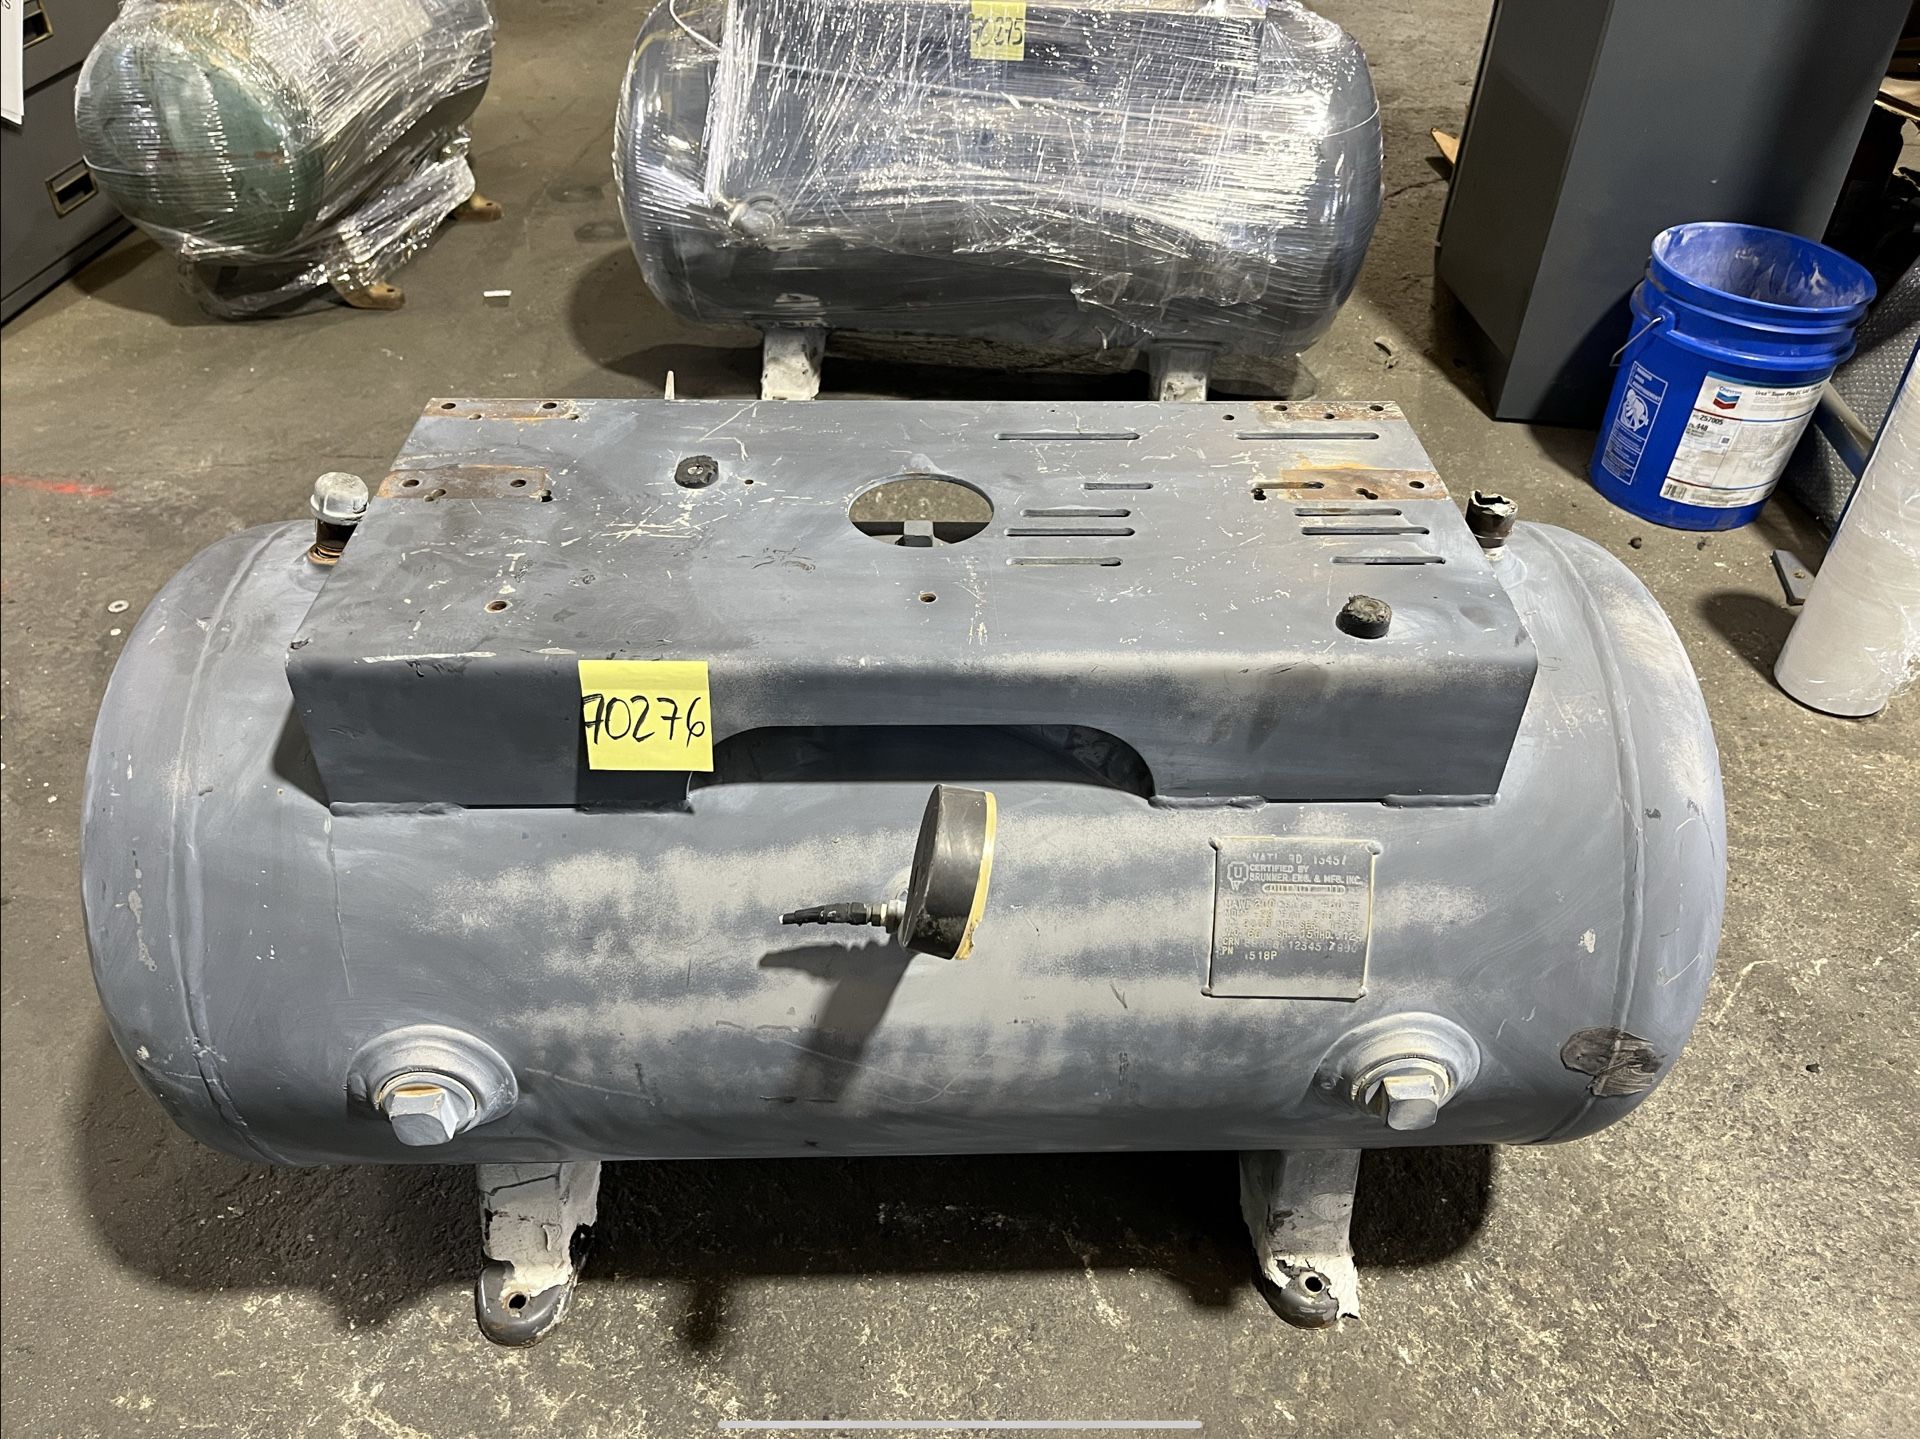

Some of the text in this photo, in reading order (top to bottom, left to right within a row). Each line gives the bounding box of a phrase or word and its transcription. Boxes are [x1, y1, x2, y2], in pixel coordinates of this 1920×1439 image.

[972, 16, 1024, 47] 70275
[1719, 386, 1742, 395] Chevron
[1699, 414, 1724, 425] 257005
[582, 693, 705, 747] 70276
[1250, 864, 1309, 873] CERTIFIED BY
[1250, 873, 1288, 882] BRUNNER
[1314, 874, 1321, 883] &
[1346, 875, 1363, 885] INC.
[1222, 937, 1239, 946] CRN
